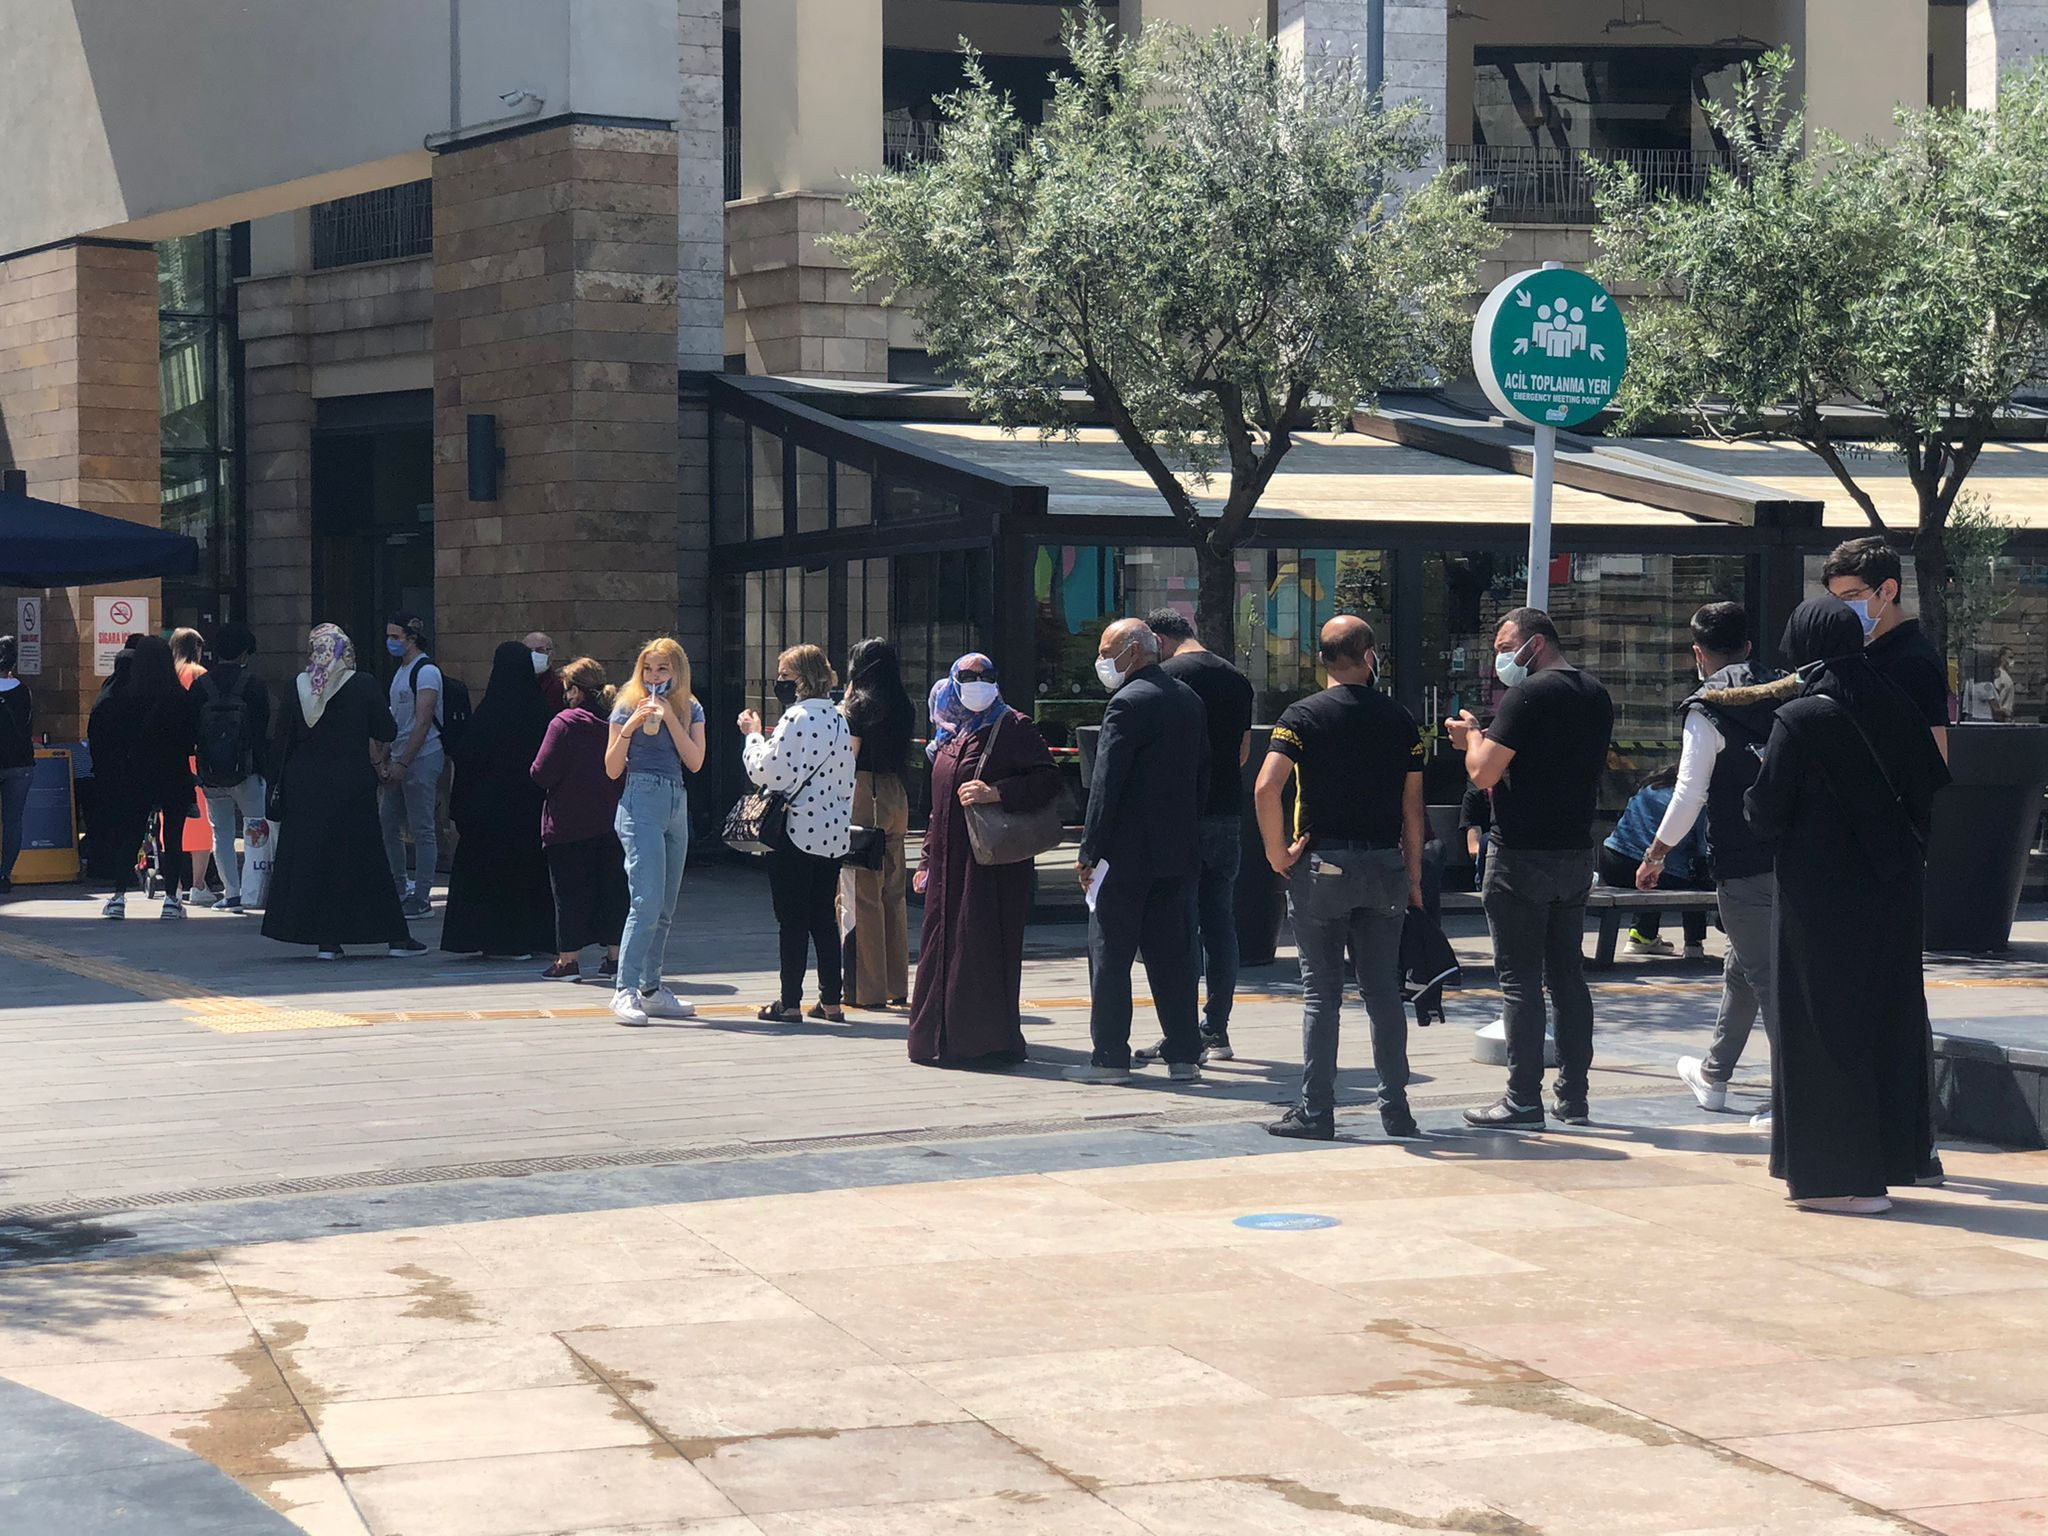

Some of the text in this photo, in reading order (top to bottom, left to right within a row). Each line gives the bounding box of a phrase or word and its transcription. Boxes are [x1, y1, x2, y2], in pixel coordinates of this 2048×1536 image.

[1504, 369, 1611, 395] ACİL TOPLANMA YERİ
[1513, 391, 1601, 405] EMERGENCY MEETING POINT
